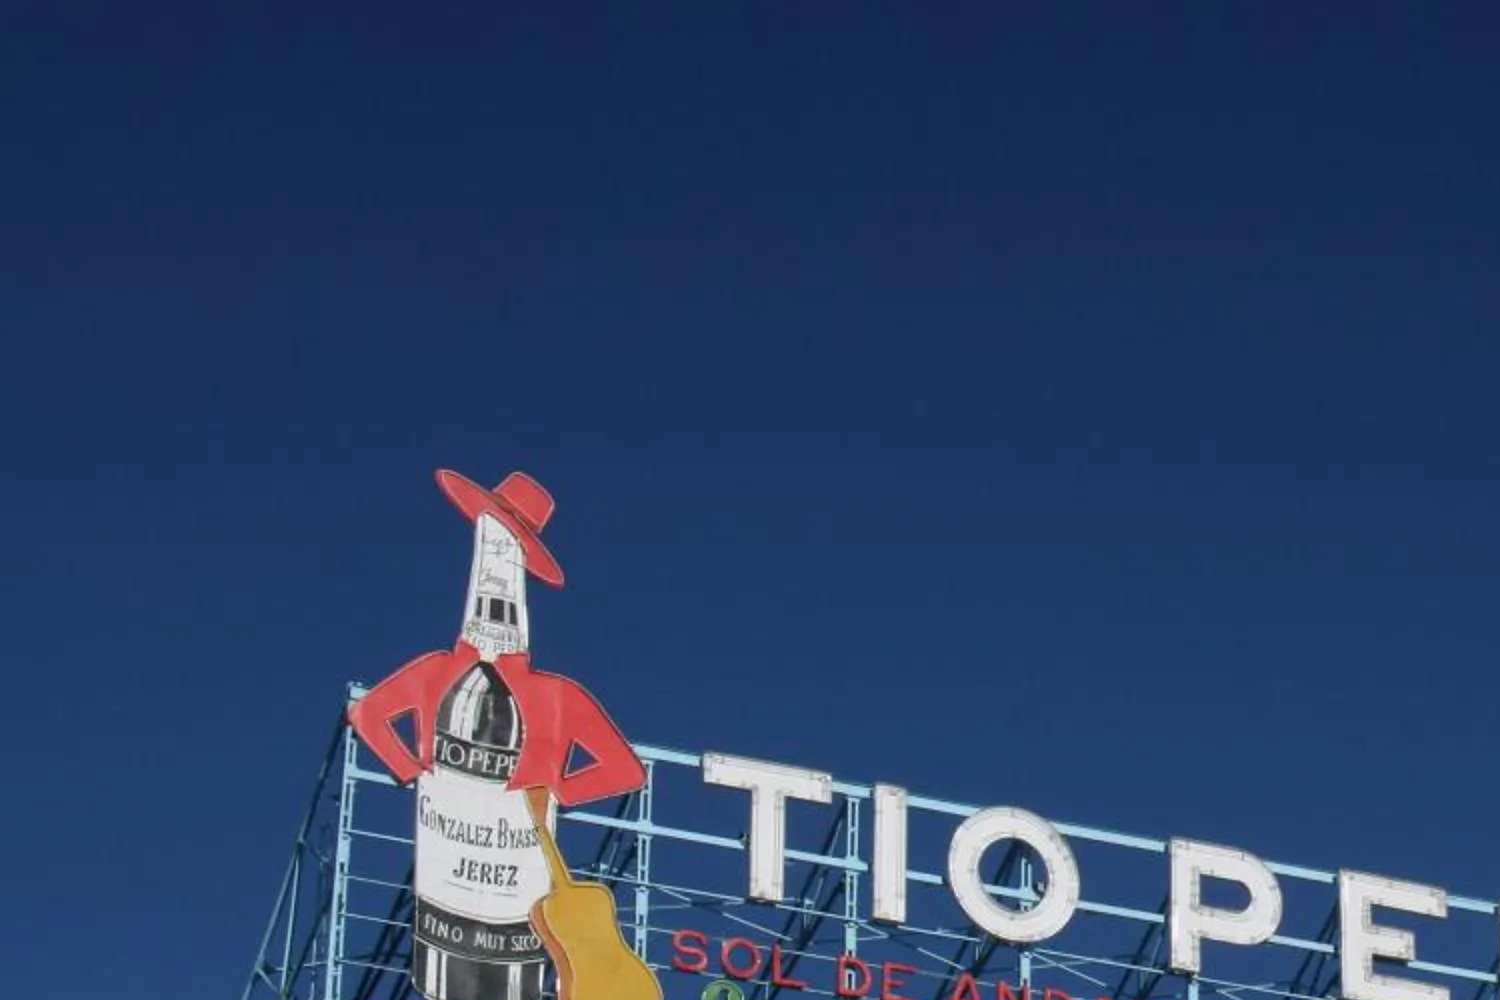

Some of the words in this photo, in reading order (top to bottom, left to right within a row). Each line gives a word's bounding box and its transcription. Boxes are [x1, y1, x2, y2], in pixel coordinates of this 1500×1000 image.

[418, 794, 494, 849] GONZALEZ
[497, 817, 540, 849] BYASS
[702, 751, 1081, 944] TIO
[451, 856, 519, 887] JEREZ
[423, 912, 464, 943] FINO
[473, 929, 507, 950] MUY
[671, 930, 806, 990] SOL
